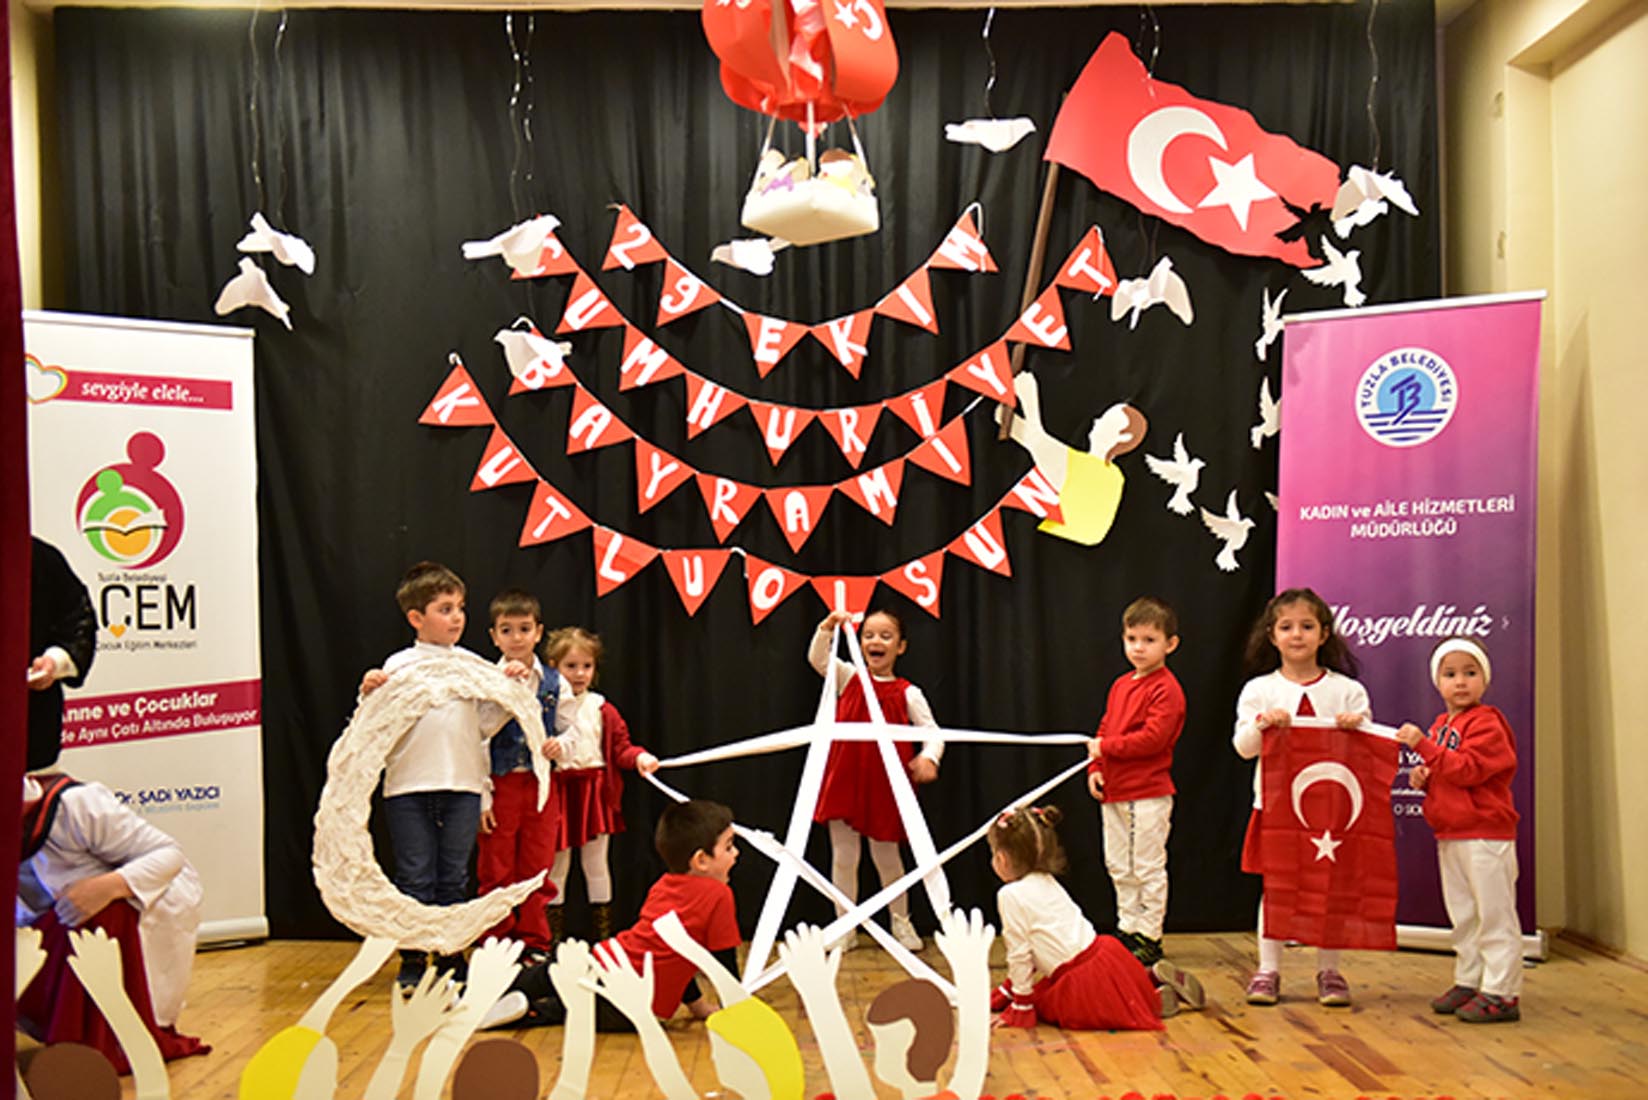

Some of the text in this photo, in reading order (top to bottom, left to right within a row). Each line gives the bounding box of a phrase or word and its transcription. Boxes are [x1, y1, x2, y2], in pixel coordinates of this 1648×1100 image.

[609, 223, 704, 314] 29
[81, 380, 149, 402] sevgiyle
[1361, 364, 1389, 408] TUZLA
[431, 383, 704, 598] KUTLU
[1300, 493, 1516, 520] KADIN ve AİLE HİZMETLERİ
[1351, 517, 1458, 539] MÜDÜRLÜĞÜ
[62, 690, 218, 723] nne ve Çocuklar
[78, 726, 109, 744] Aynı
[111, 722, 141, 739] Çatı
[142, 716, 190, 734] Altında
[193, 708, 257, 729] Buluşuyor
